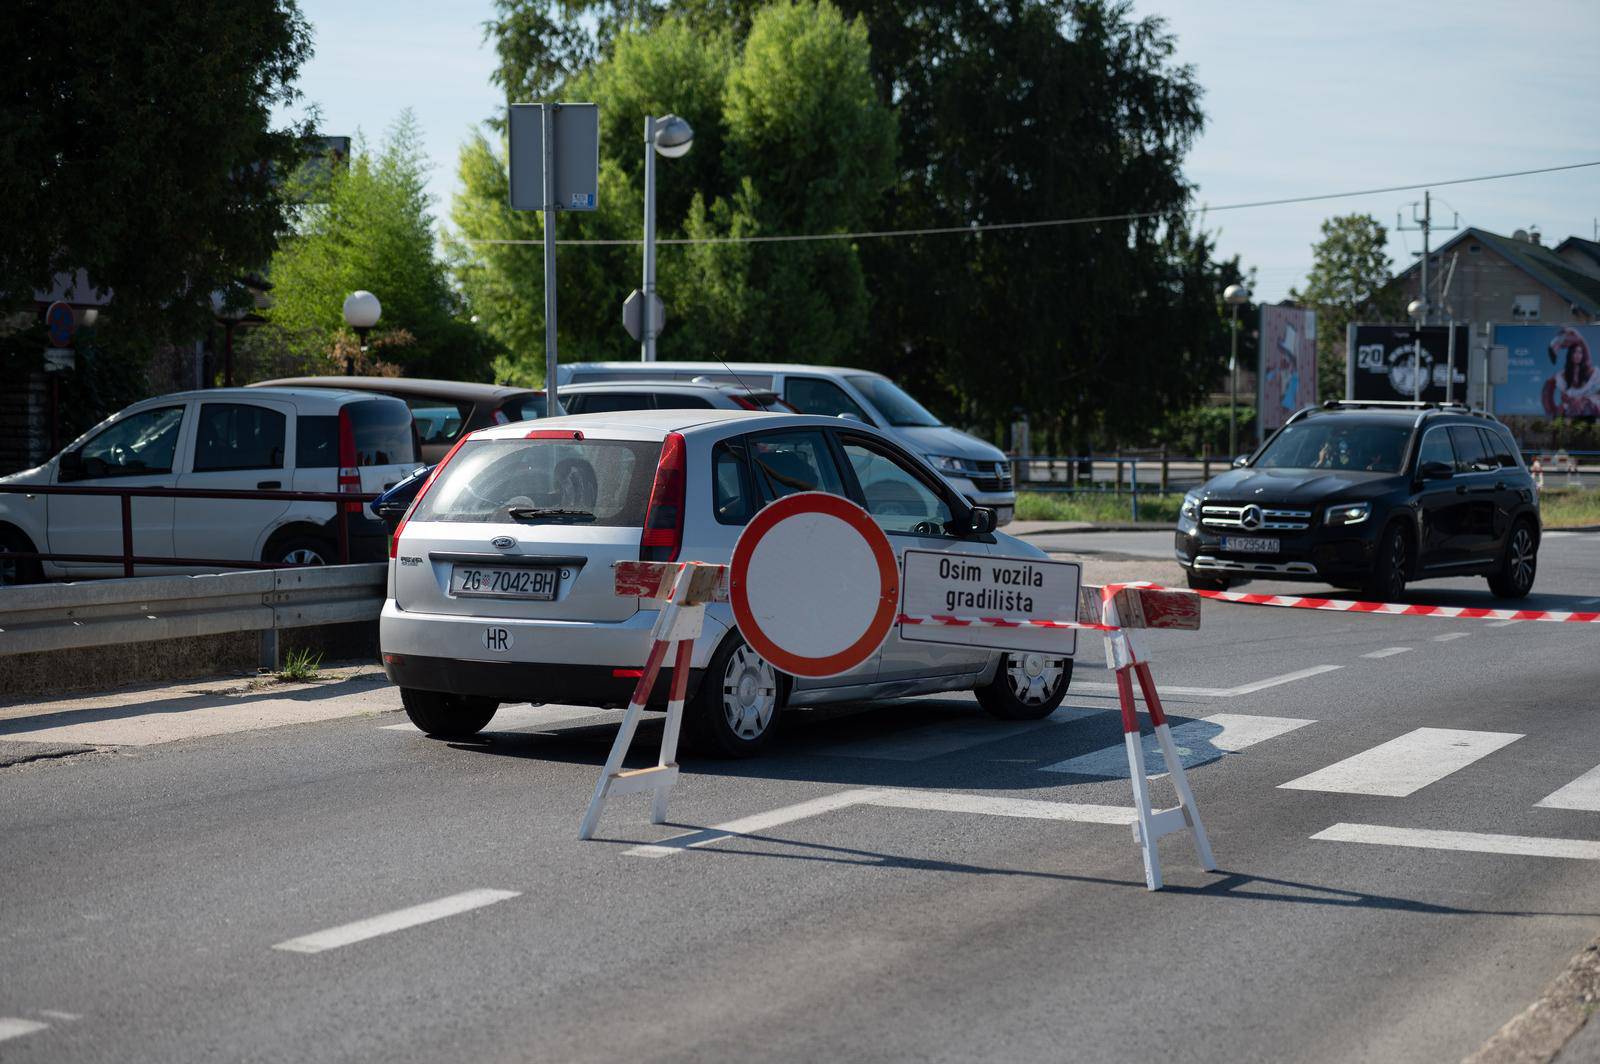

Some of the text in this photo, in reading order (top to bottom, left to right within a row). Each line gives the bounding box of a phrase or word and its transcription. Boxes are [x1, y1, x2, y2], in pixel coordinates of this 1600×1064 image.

[1360, 348, 1381, 364] 20
[462, 570, 481, 590] ZG
[939, 558, 1043, 587] Osim vozila
[946, 588, 1034, 613] gradilišta
[487, 629, 508, 650] HR
